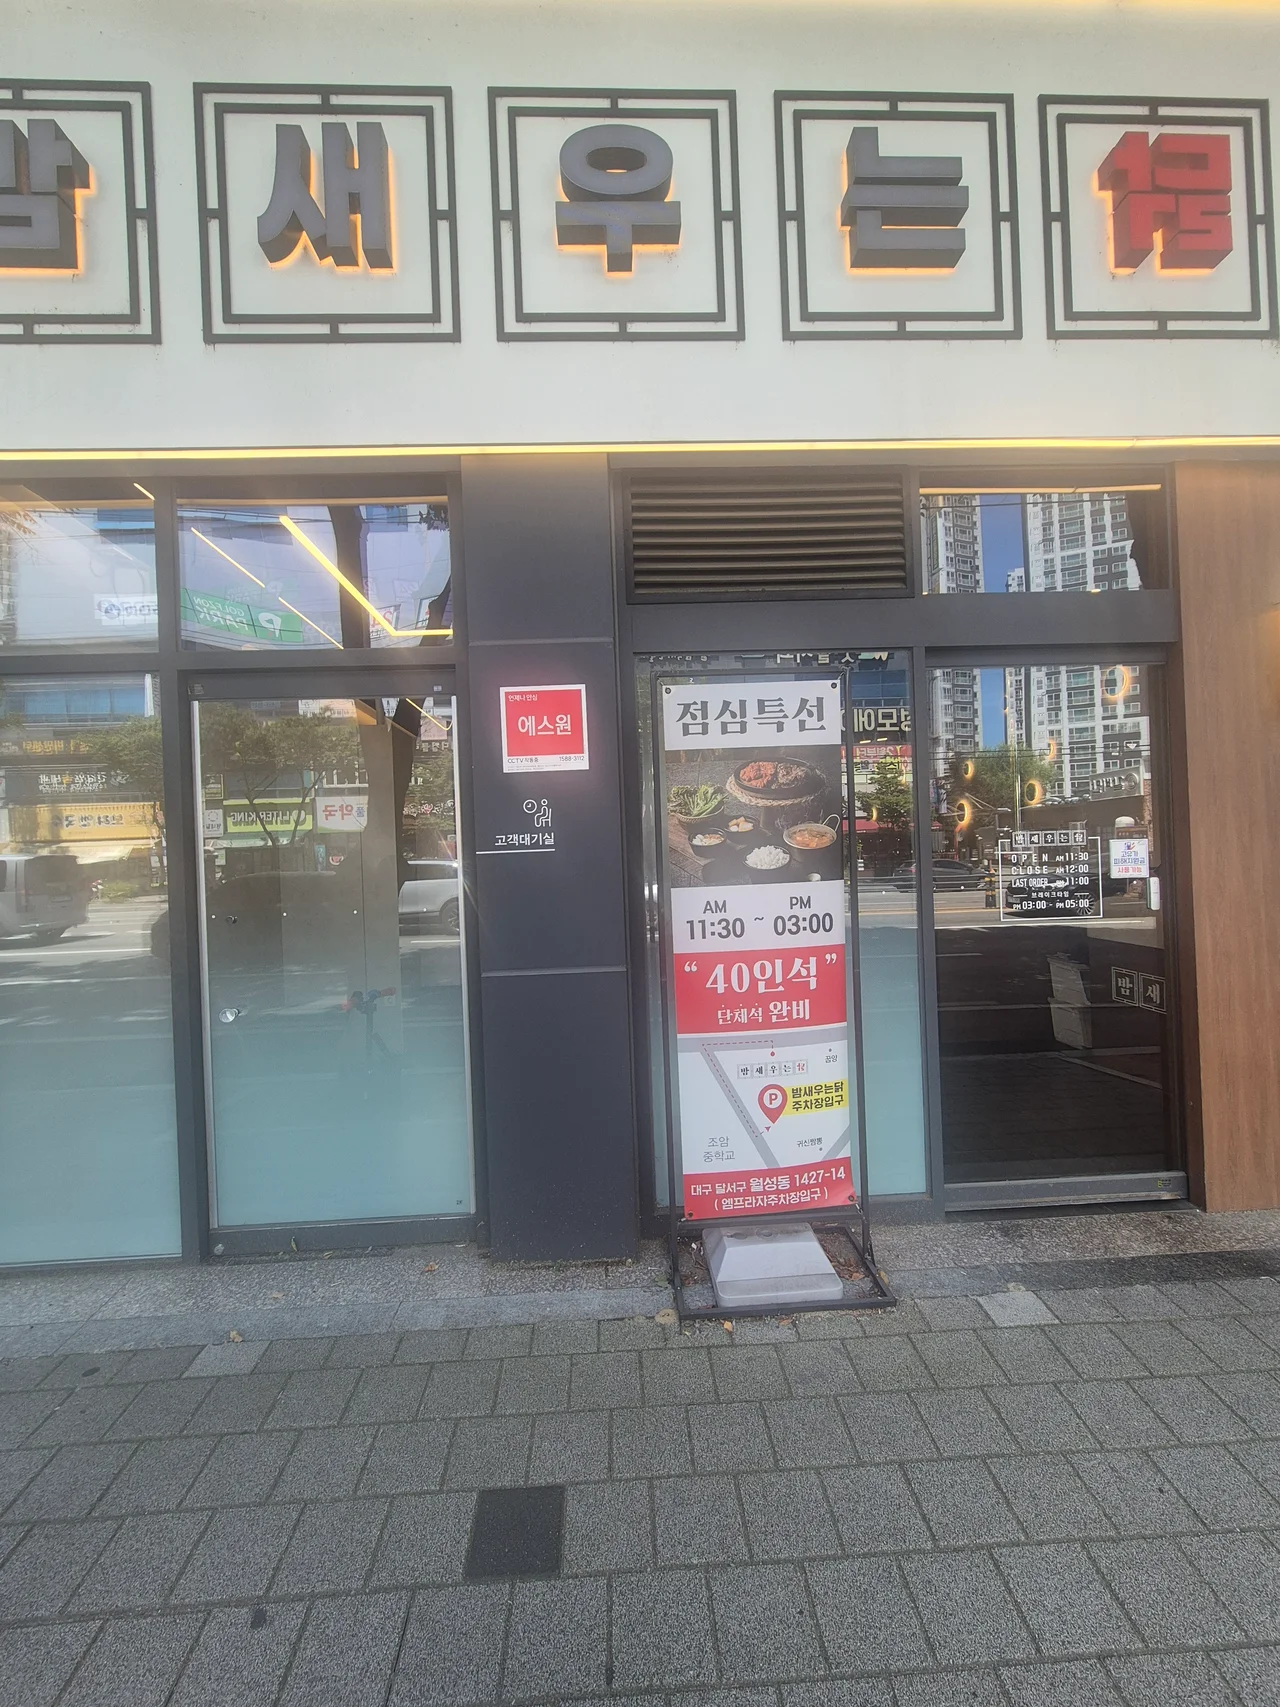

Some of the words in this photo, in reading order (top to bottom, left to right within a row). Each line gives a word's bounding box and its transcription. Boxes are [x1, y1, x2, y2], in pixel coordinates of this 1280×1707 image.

[517, 714, 572, 737] 에스원
[675, 696, 827, 737] 점심특선
[494, 832, 555, 847] 고객대기실
[1065, 852, 1089, 861] 11:30
[1065, 864, 1089, 873] 12:00
[1011, 878, 1027, 888] LAST
[703, 900, 727, 914] AM
[789, 896, 812, 910] PM
[1022, 900, 1046, 910] 03:00
[1065, 899, 1089, 908] 05:00
[686, 917, 745, 940] 11:30
[773, 912, 834, 936] 03:00
[717, 1005, 763, 1025] 단체석
[769, 999, 810, 1023] 완비
[791, 1080, 844, 1099] 밤새우는닭
[792, 1094, 844, 1112] 주차장입구
[707, 1136, 730, 1148] 조암
[703, 1150, 735, 1163] 중학교
[691, 1183, 712, 1196] 대구
[715, 1180, 747, 1194] 달서구
[749, 1175, 790, 1193] 월성동
[794, 1166, 846, 1187] 1427-14
